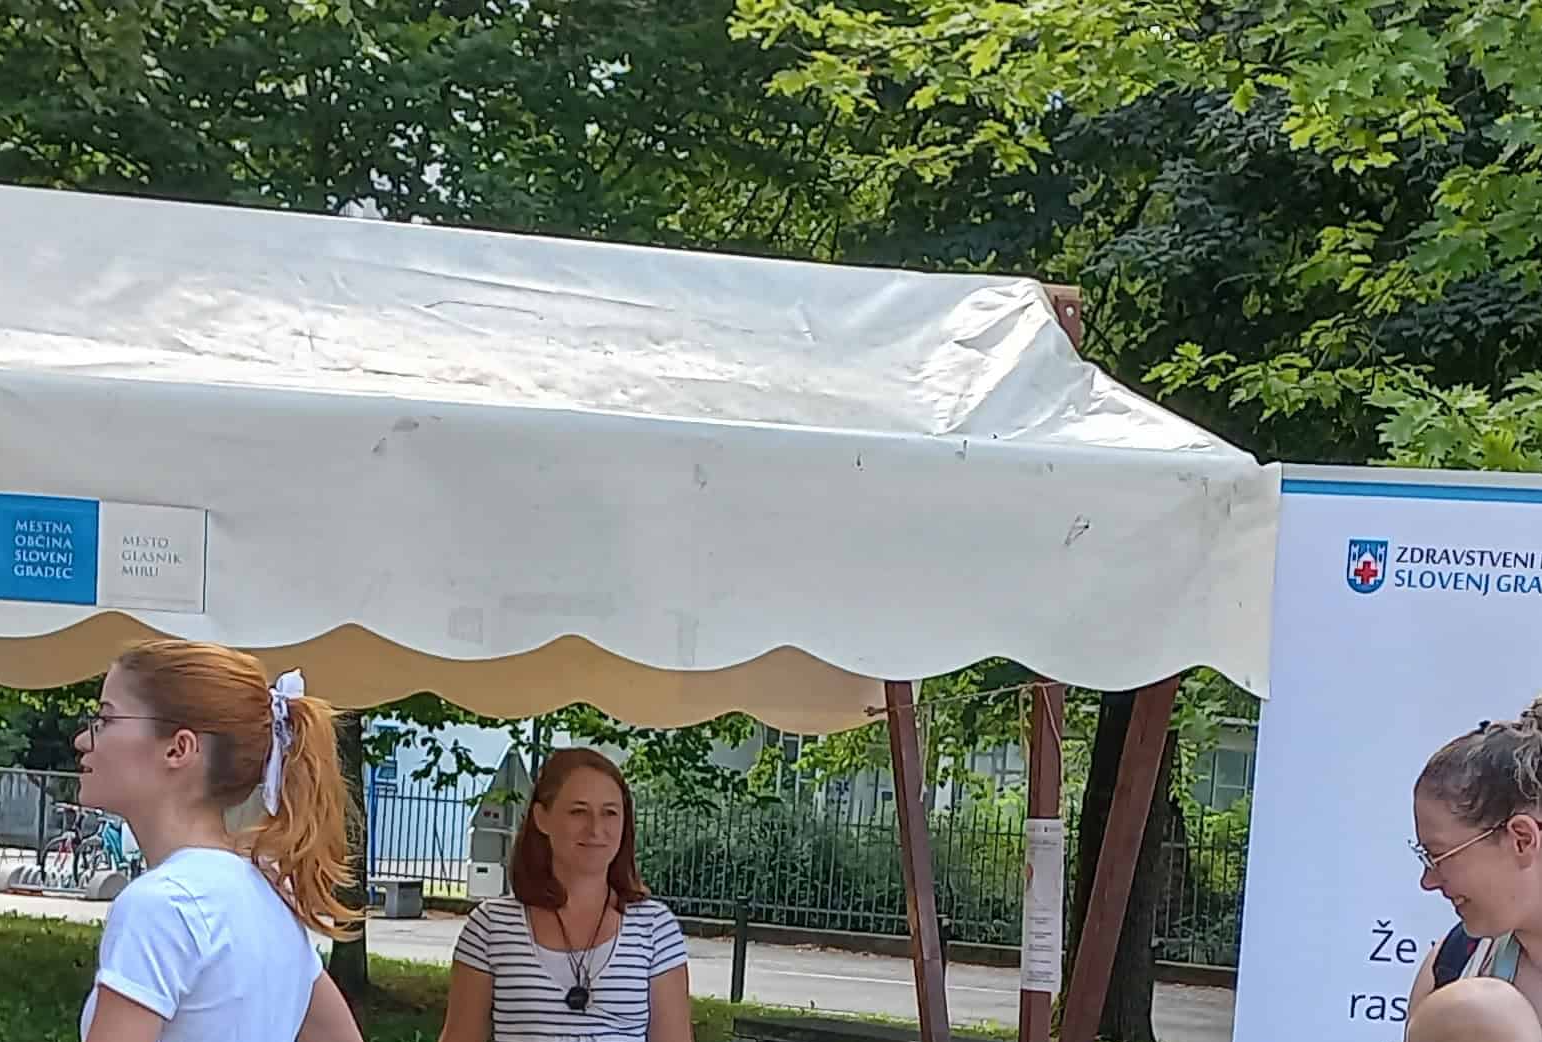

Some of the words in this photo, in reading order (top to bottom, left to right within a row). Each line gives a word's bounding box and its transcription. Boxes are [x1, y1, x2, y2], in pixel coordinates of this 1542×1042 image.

[15, 520, 73, 534] MESTNA
[14, 533, 73, 549] OBČINA
[122, 535, 170, 549] MESTO
[14, 549, 73, 566] SLOVENJ
[120, 550, 182, 564] GLASNIK
[1395, 546, 1535, 569] ZDRAVSTVENI
[13, 564, 74, 580] GRADEC
[121, 565, 160, 578] MIRU
[1394, 568, 1490, 596] SLOVENJ
[1369, 919, 1418, 964] Že
[1349, 993, 1409, 1022] ras
